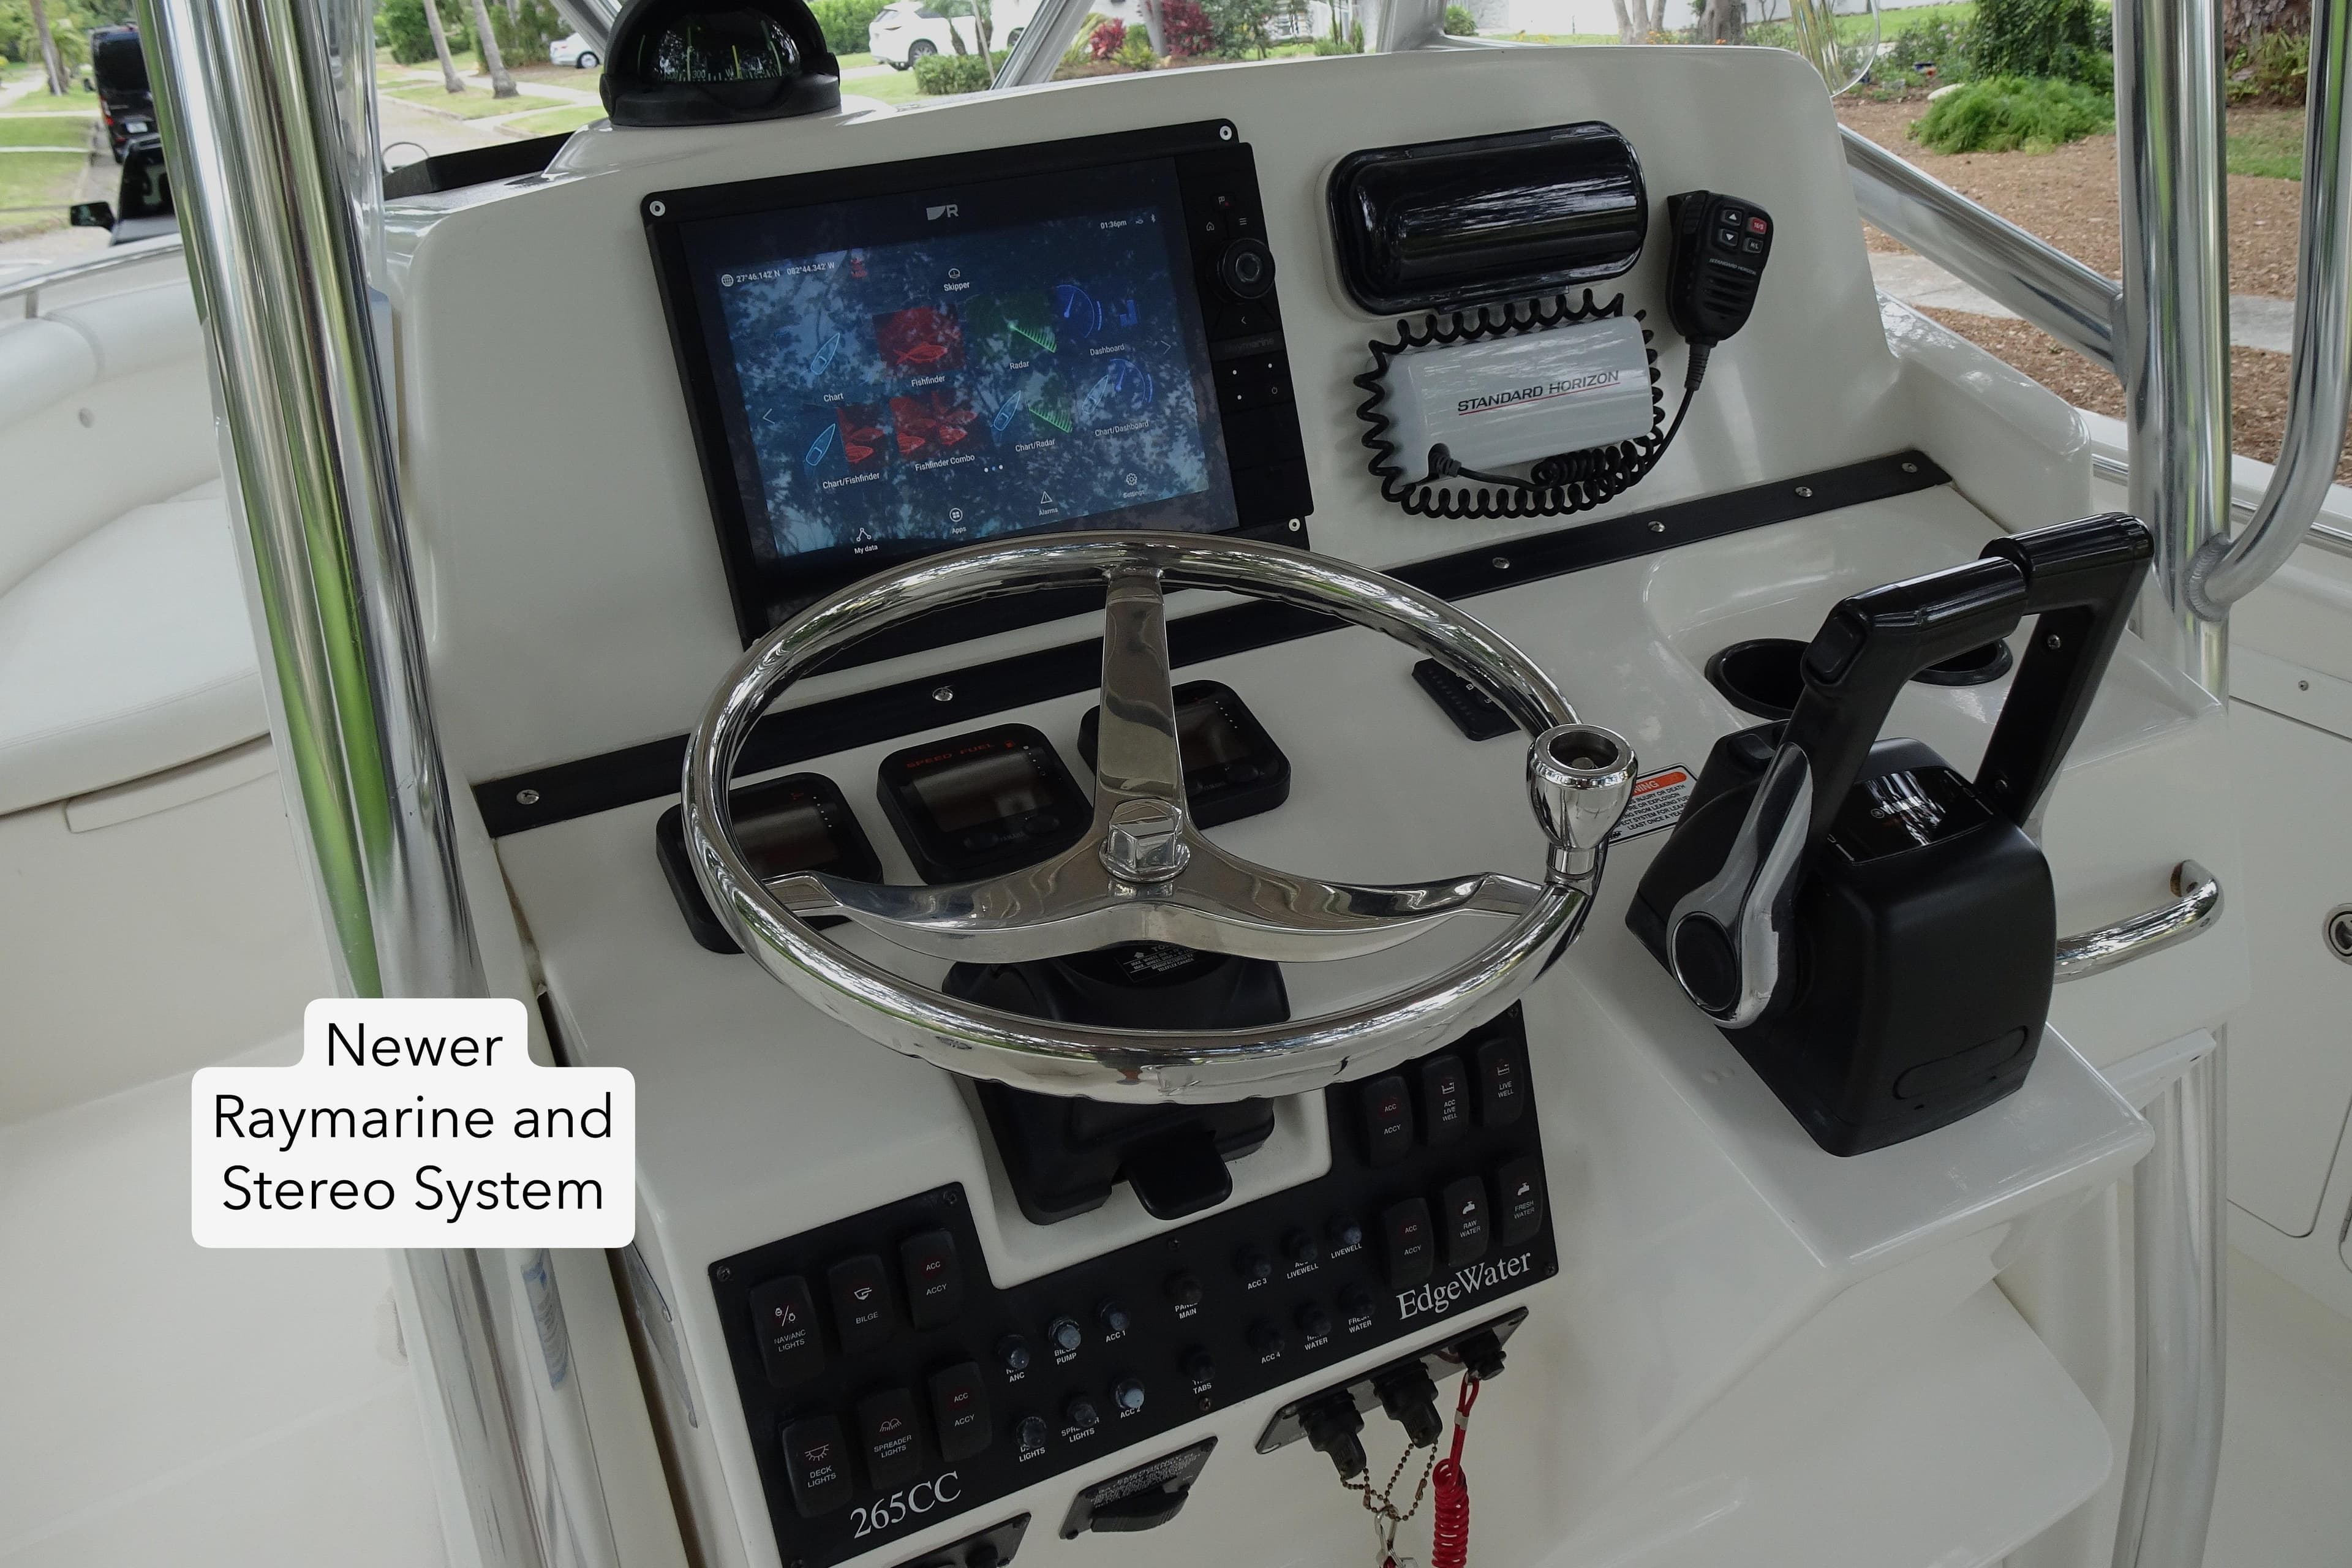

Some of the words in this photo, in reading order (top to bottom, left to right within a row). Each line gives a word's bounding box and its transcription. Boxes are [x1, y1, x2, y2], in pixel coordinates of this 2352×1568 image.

[1101, 219, 1127, 229] 01:36pm
[944, 281, 970, 292] Skipper
[1090, 343, 1125, 356] Dashboard
[1009, 360, 1030, 371] Radar
[911, 375, 946, 387] Fishfinder
[823, 392, 844, 402] Chart
[1457, 386, 1544, 412] STANDARD
[1549, 370, 1619, 396] HORIZON
[1095, 420, 1149, 437] Chart/Dashboard
[1015, 439, 1055, 453] Chart/Radar
[914, 459, 949, 472] Fishfinder
[950, 454, 976, 466] Combo
[823, 472, 880, 490] Chart/Fishfinder
[1123, 490, 1145, 499] Settings
[1039, 507, 1058, 516] Alarms
[951, 526, 967, 535] Apps
[854, 546, 865, 556] My
[866, 543, 878, 552] data
[906, 753, 953, 769] SPEED
[1634, 780, 1659, 793] NING
[1667, 784, 1686, 793] DEATH
[1647, 793, 1680, 805] EXPLOSION
[1653, 799, 1677, 810] LEAKING
[1634, 812, 1656, 822] SYSTEM
[1669, 802, 1686, 812] LEAK
[1627, 821, 1647, 830] LEAST
[1499, 1081, 1512, 1090] LIVE
[1498, 1088, 1514, 1098] WELL
[1384, 1103, 1396, 1112] ACC
[1444, 1106, 1456, 1115] LIVE
[1442, 1113, 1458, 1121] WELL
[1384, 1124, 1401, 1134] ACCY
[1515, 1200, 1534, 1212] FRESH
[1513, 1207, 1534, 1219] WATER
[1405, 1224, 1417, 1234] ACC
[1463, 1220, 1477, 1229] RAW
[1460, 1226, 1481, 1238] WATER
[1331, 1243, 1362, 1259] LIVEWELL
[1404, 1245, 1422, 1256] ACCY
[925, 1261, 941, 1271] ACC
[1287, 1263, 1318, 1280] LIVEWELL
[926, 1283, 947, 1296] ACCY
[1248, 1280, 1262, 1290] ACC
[1396, 1252, 1531, 1320] EdgeWater
[856, 1311, 879, 1324] BILGE
[1179, 1308, 1197, 1319] MAIN
[1349, 1319, 1372, 1333] WATER
[774, 1329, 806, 1345] NAV/ANC
[1106, 1332, 1121, 1343] ACC
[778, 1338, 805, 1352] LIGHTS
[1304, 1337, 1328, 1351] WATER
[1056, 1352, 1077, 1365] PUMP
[1261, 1353, 1275, 1364] ACC
[1009, 1371, 1025, 1382] ANC
[1193, 1382, 1212, 1395] TABS
[954, 1392, 968, 1403] ACC
[1120, 1409, 1135, 1419] ACC
[954, 1414, 974, 1427] ACCY
[1069, 1428, 1095, 1443] LIGHTS
[873, 1434, 912, 1453] SPREADER
[881, 1445, 907, 1458] LIGHTS
[1019, 1447, 1046, 1463] LIGHTS
[810, 1465, 832, 1479] DECK
[807, 1472, 837, 1488] LIGHTS
[850, 1471, 961, 1539] 265CC
